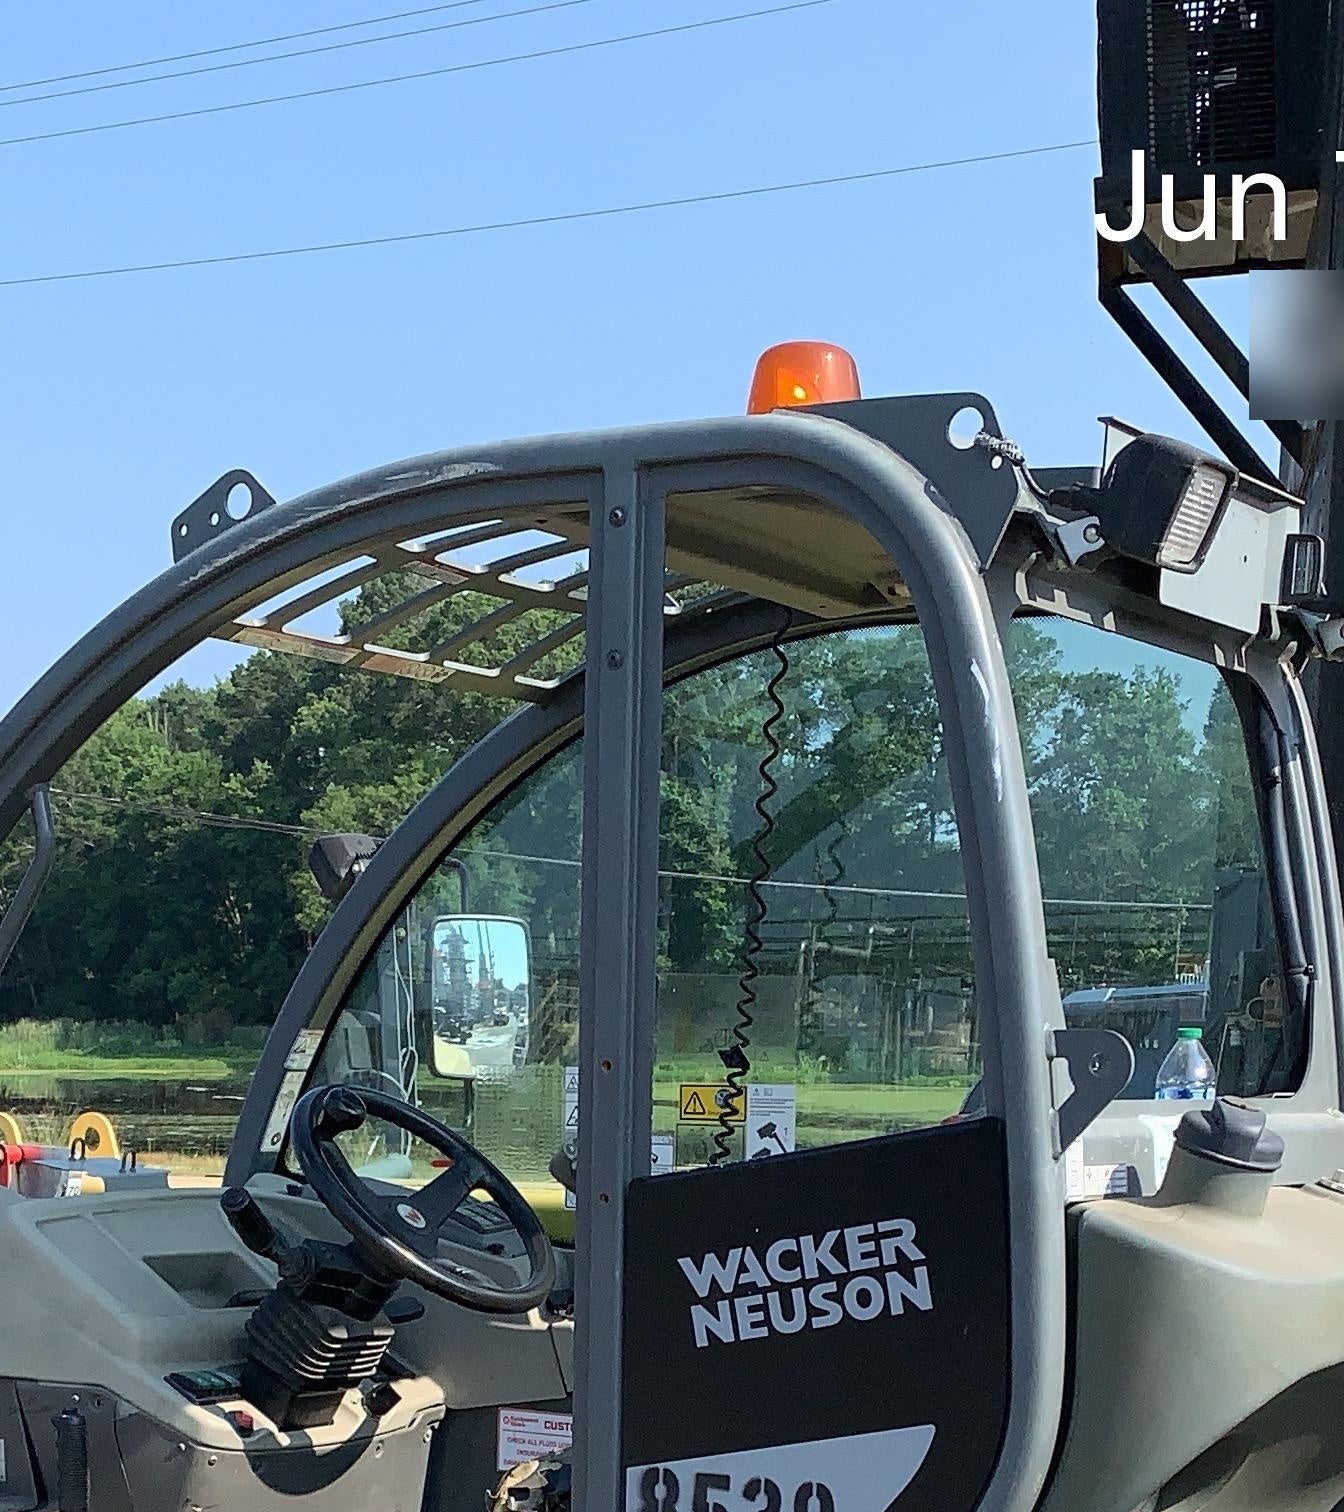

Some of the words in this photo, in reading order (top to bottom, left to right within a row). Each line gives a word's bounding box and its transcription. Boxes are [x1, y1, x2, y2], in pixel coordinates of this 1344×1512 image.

[678, 1219, 925, 1297] WACKER
[691, 1266, 932, 1347] NEUSON
[544, 1420, 571, 1431] CUST
